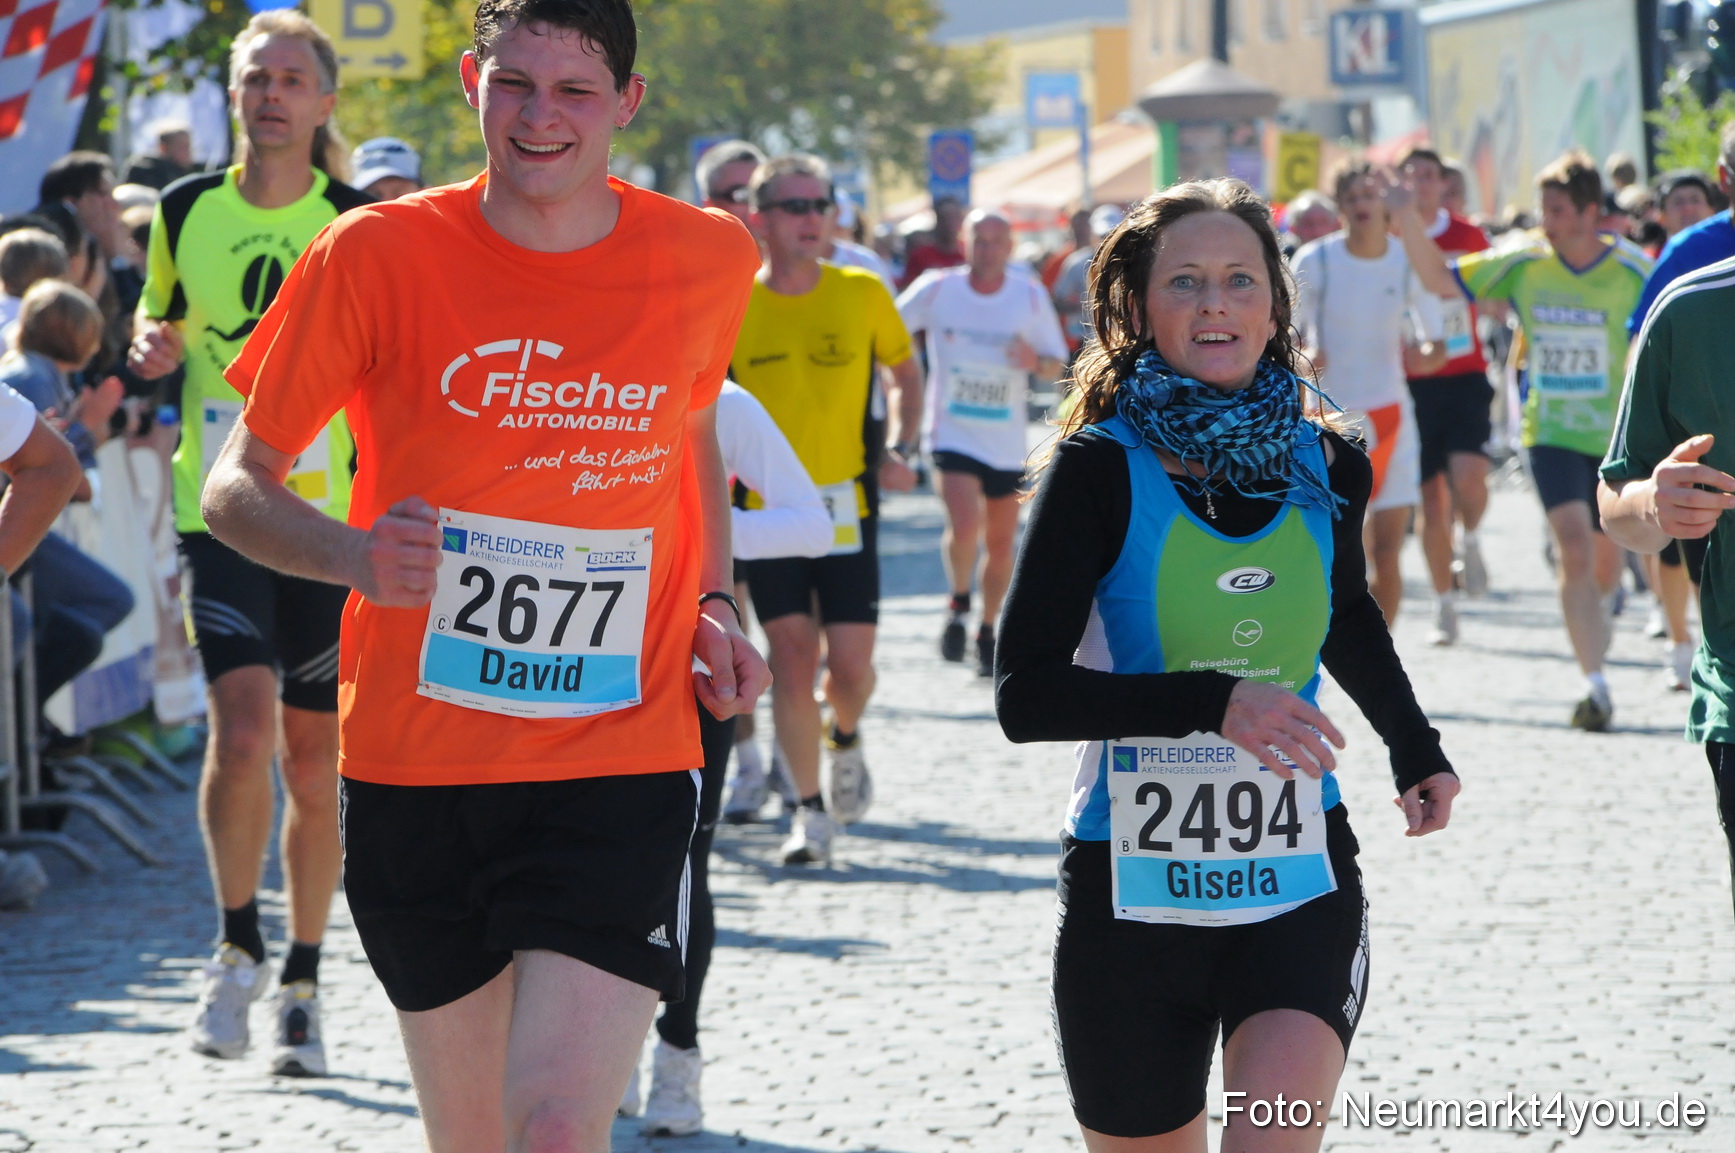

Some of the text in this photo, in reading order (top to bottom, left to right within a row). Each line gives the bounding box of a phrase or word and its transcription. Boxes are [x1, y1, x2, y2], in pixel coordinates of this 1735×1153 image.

[1286, 155, 1312, 191] C
[481, 372, 667, 410] Fischer
[498, 413, 651, 431] AUTOMOBILE
[524, 450, 565, 469] und
[569, 446, 607, 467] das
[572, 462, 666, 495] fährt mit!
[470, 531, 565, 560] PFLEIDERER
[469, 550, 563, 571] AKTIENGESELLSCHAFT
[587, 551, 636, 564] BOCK
[453, 565, 625, 648] 2677
[437, 617, 446, 630] C
[479, 648, 584, 692] David
[1190, 657, 1249, 669] Reisebüro
[1141, 746, 1236, 763] PFLEIDERER
[1141, 765, 1236, 774] AKTIENGESELLSCHAFT
[1135, 780, 1303, 853] 2494
[1122, 840, 1130, 853] B
[1166, 861, 1280, 900] Gisela
[647, 935, 671, 948] adidas
